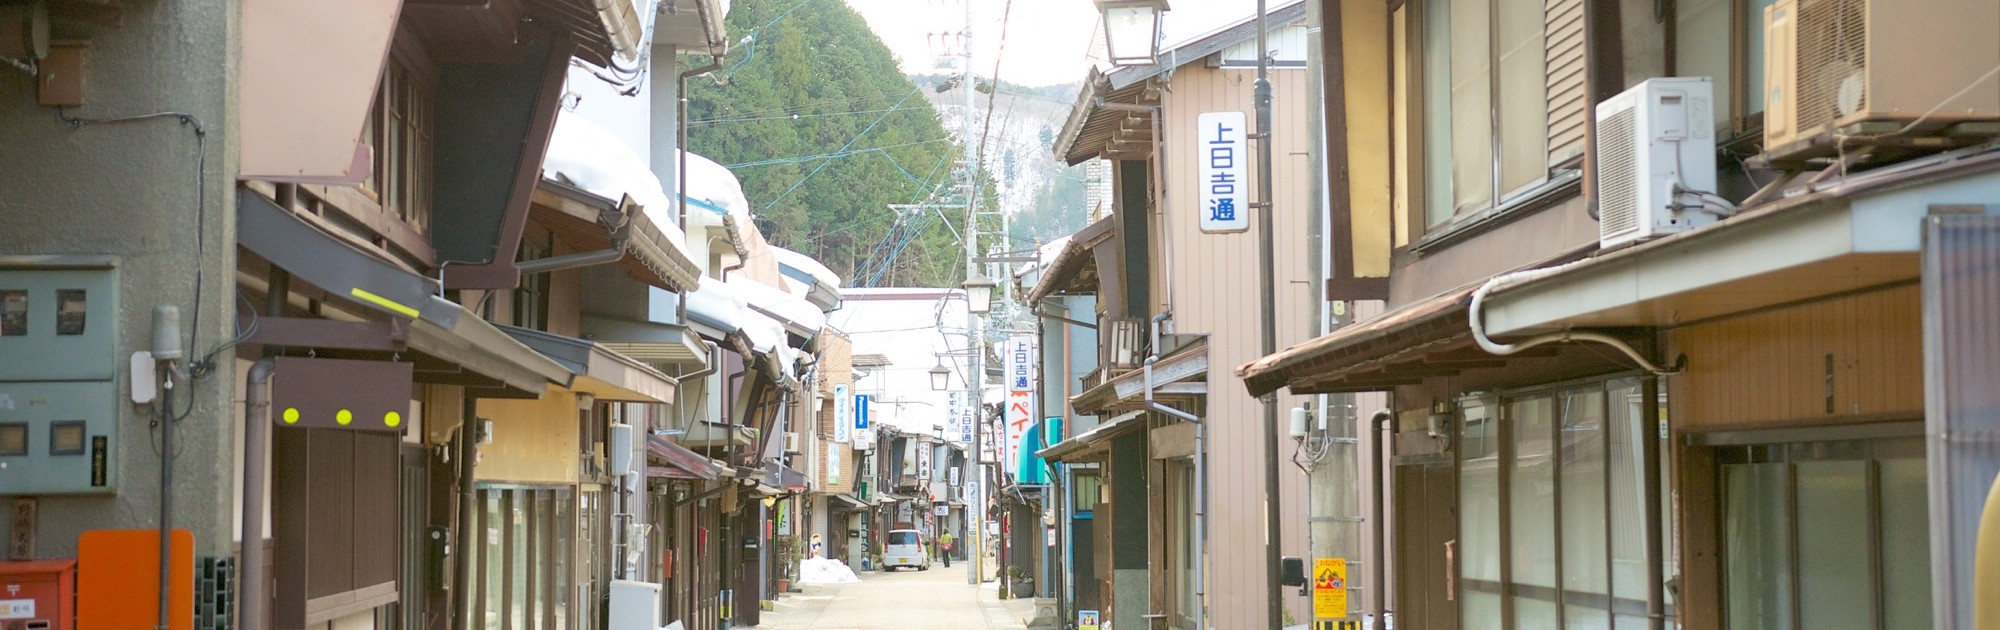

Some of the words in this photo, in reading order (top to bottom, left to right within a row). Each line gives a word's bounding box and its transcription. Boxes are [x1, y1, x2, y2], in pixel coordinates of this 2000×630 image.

[1209, 122, 1235, 221] 上日吉通
[1015, 341, 1028, 388] 上日吉通
[962, 408, 972, 441] 上日吉通
